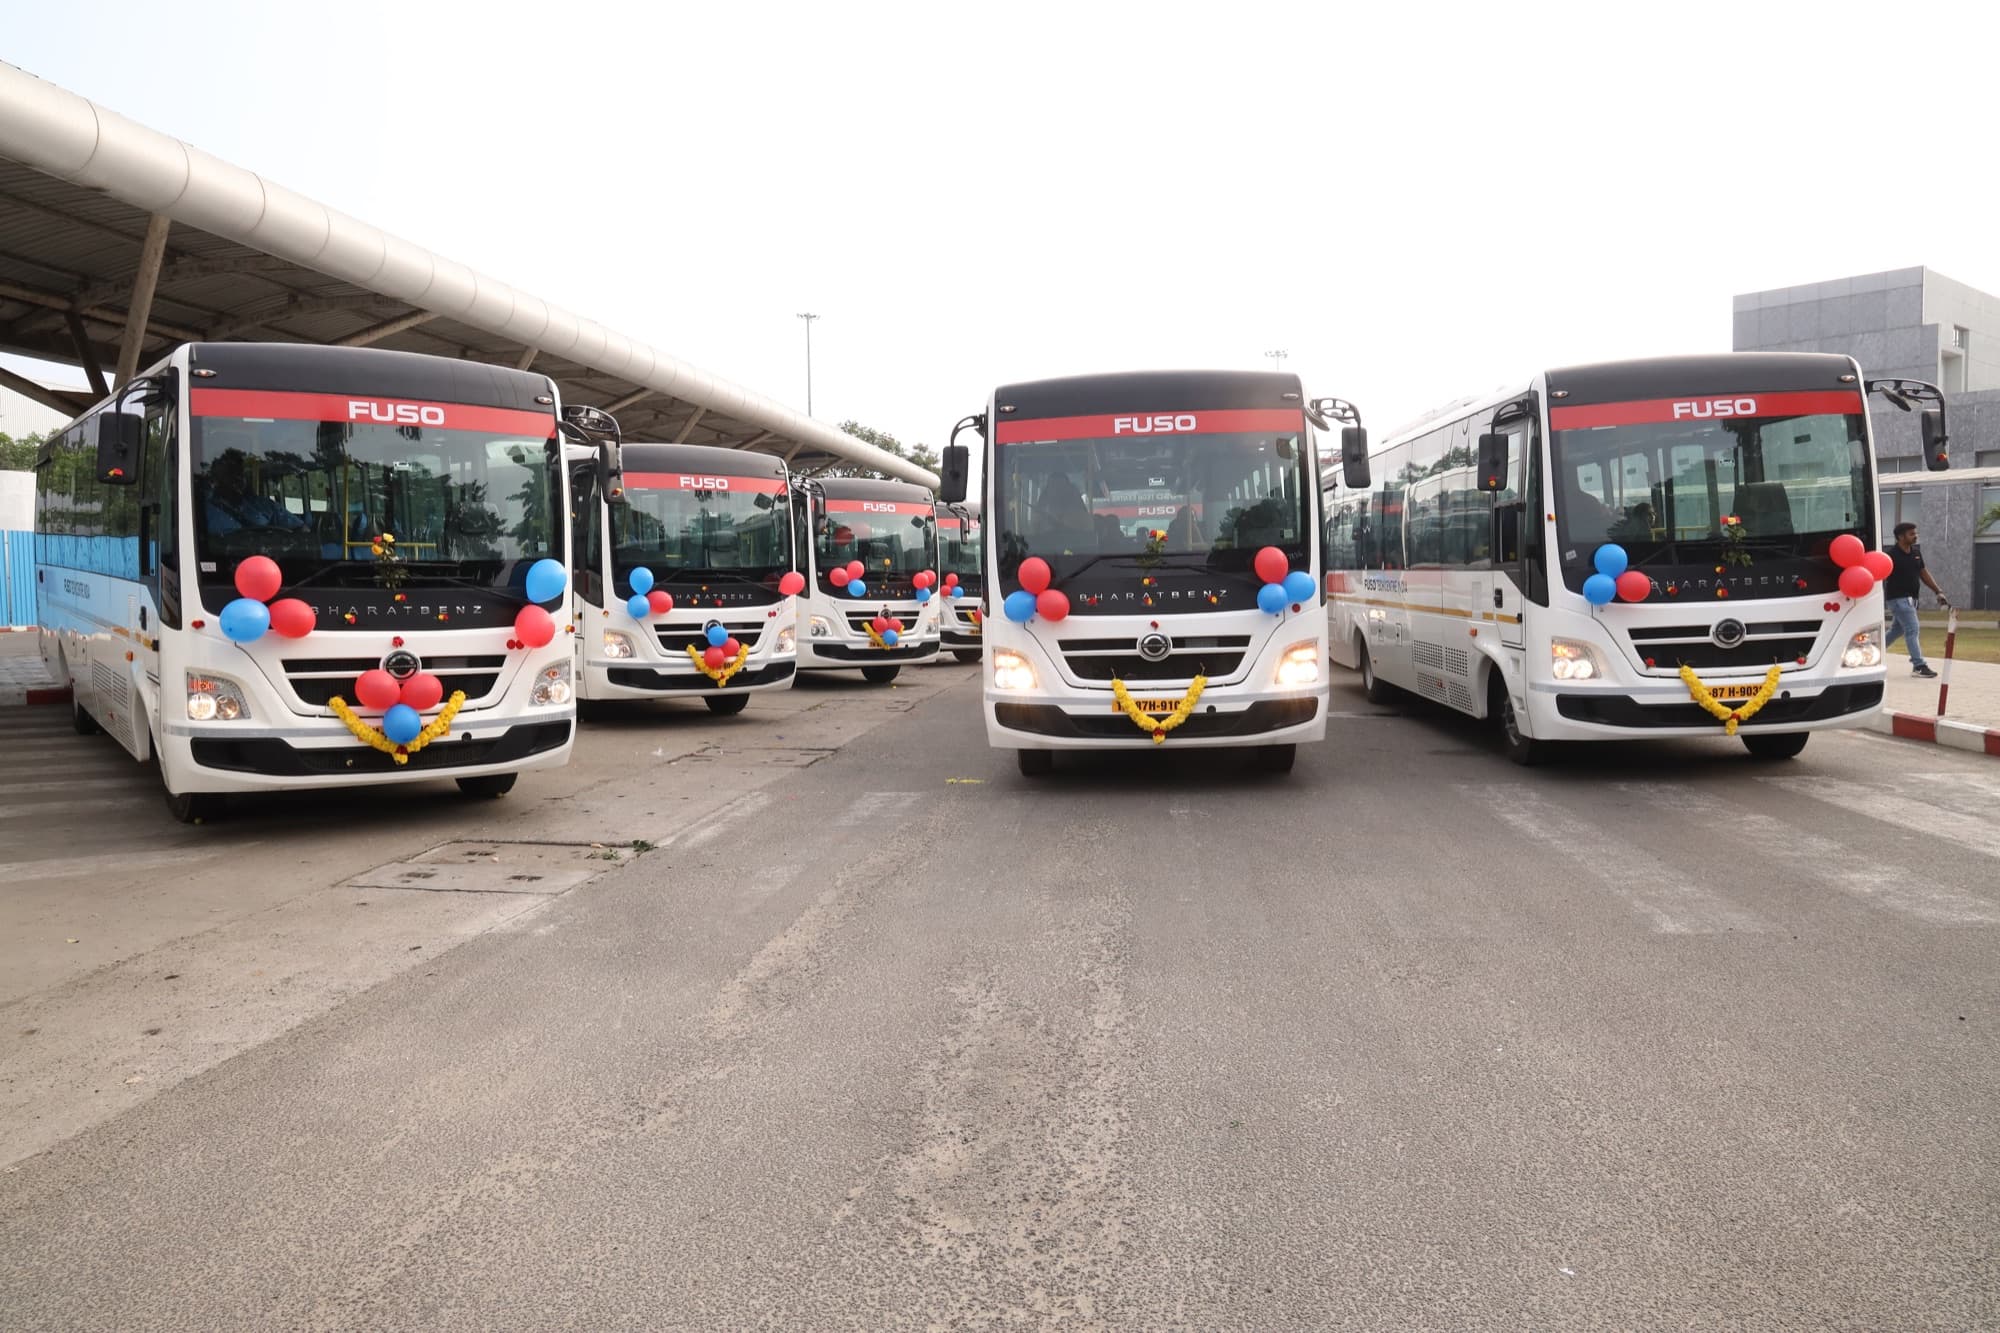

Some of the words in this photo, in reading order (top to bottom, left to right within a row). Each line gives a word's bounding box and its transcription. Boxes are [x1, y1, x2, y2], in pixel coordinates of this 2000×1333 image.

[348, 400, 445, 425] FUSO
[1673, 398, 1756, 419] FUSO
[1114, 415, 1197, 434] FUSO
[679, 476, 728, 490] FUSO
[863, 503, 896, 513] FUSO
[1138, 506, 1176, 516] FUSO
[675, 592, 753, 601] HARATBENZ
[1079, 589, 1227, 601] BHARATBENZ
[1728, 685, 1762, 697] H-903
